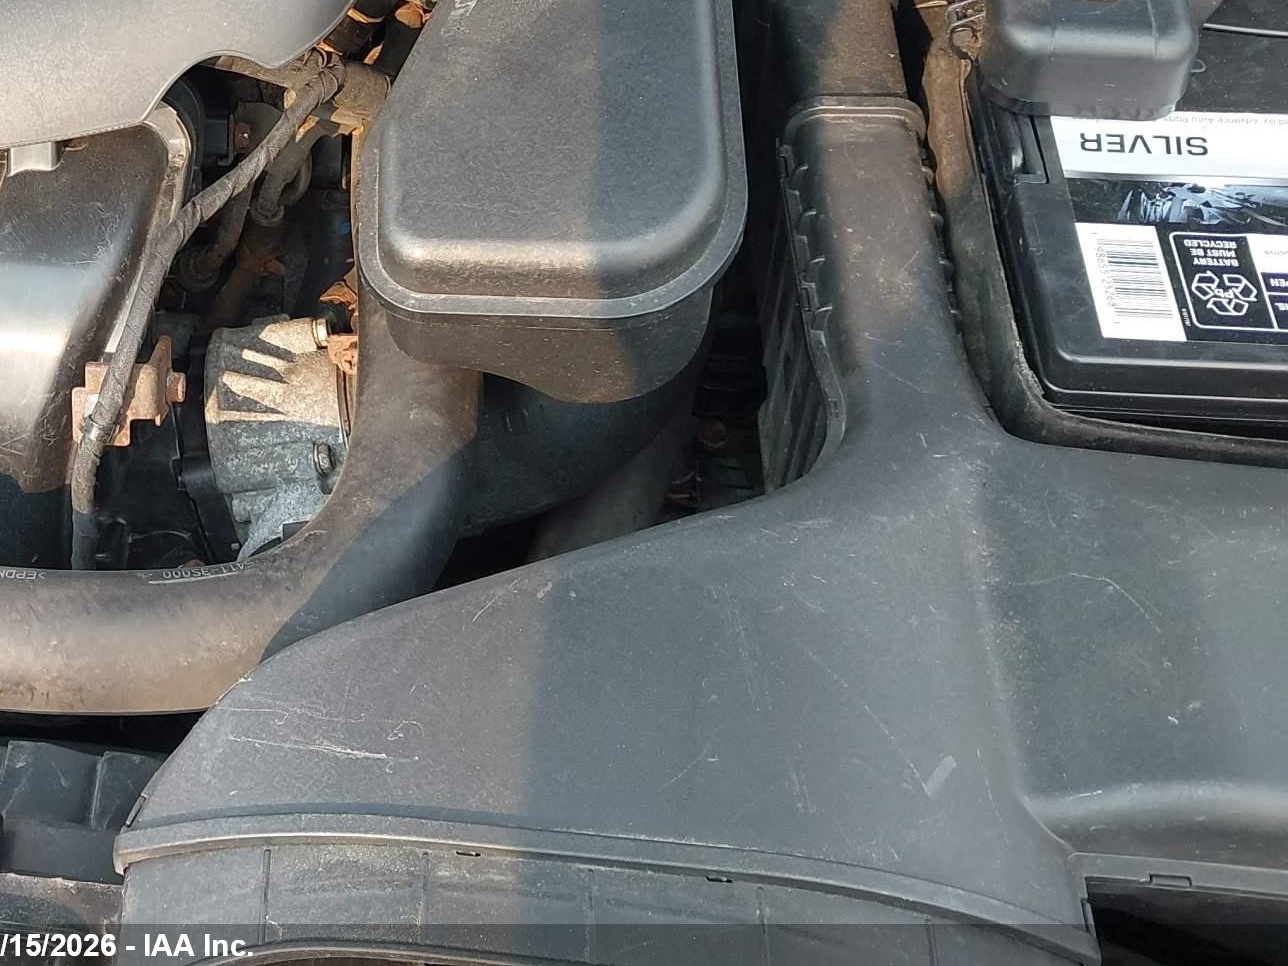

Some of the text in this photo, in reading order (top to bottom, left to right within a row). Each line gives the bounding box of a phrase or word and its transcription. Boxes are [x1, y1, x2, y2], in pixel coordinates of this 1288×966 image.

[1080, 132, 1208, 156] SILVER
[1183, 239, 1237, 248] RECYCLED
[1189, 248, 1236, 258] MUST BE
[1193, 257, 1239, 266] BATTERY
